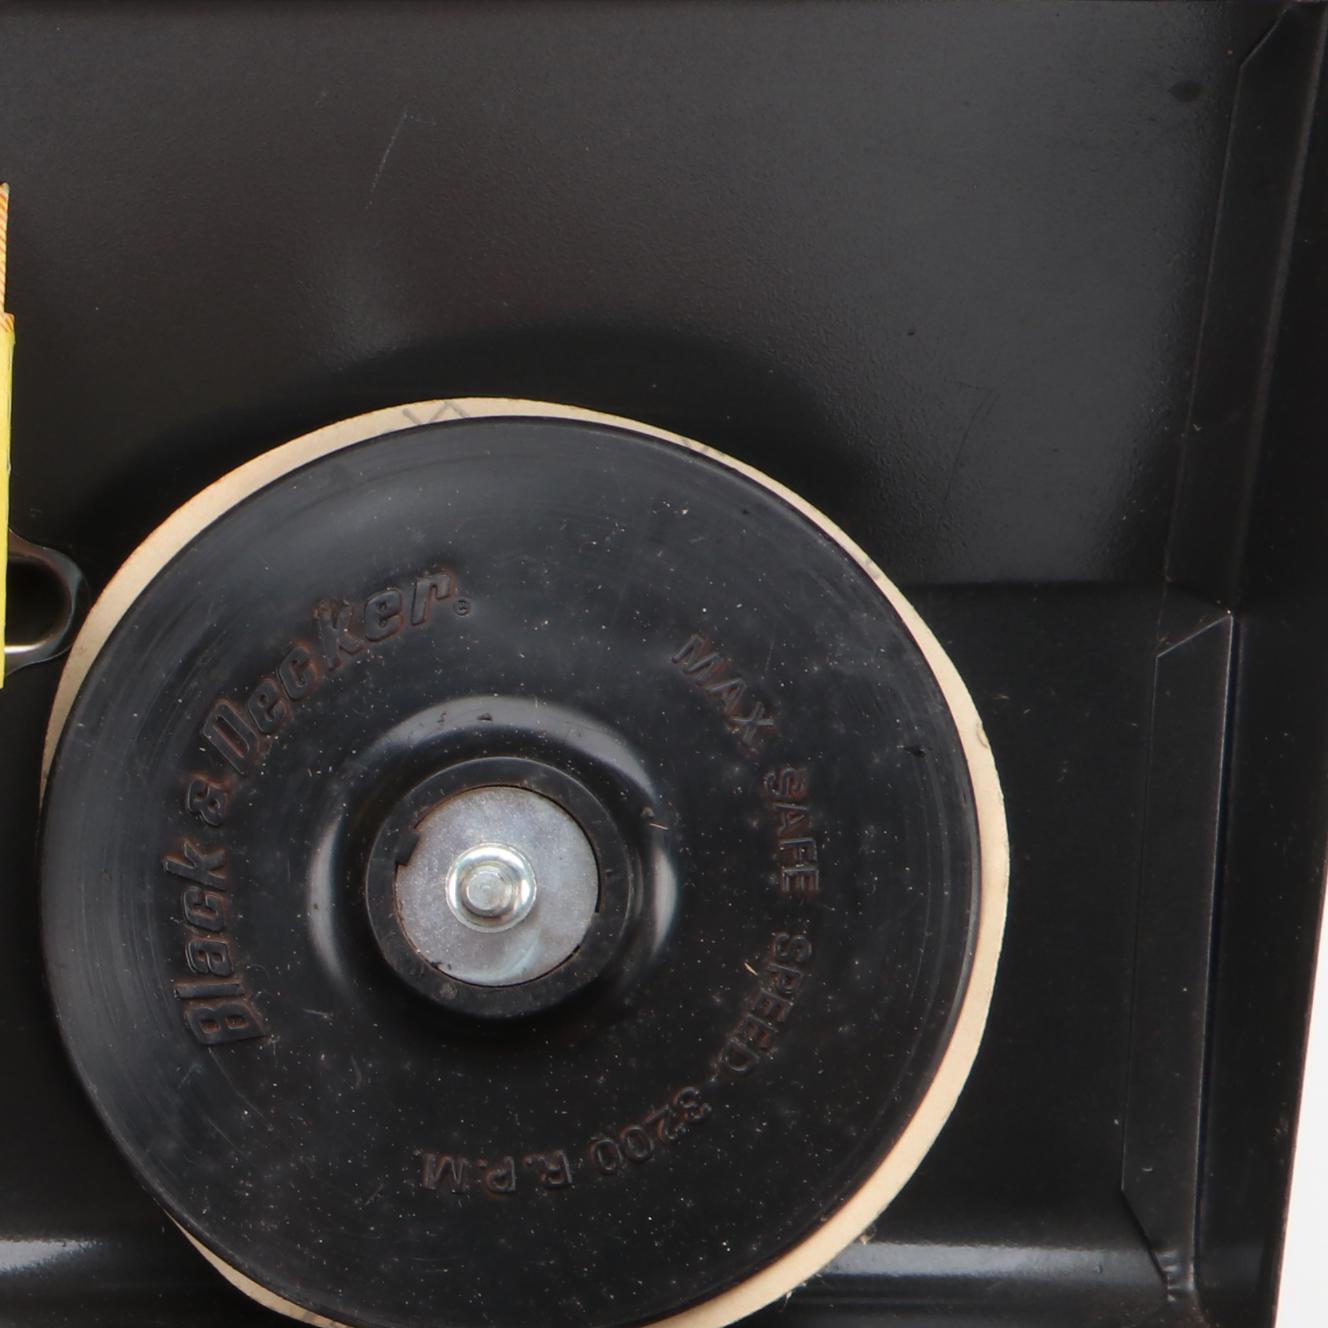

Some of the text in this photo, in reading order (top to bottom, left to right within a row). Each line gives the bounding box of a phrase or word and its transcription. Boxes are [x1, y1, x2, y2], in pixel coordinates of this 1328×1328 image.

[185, 774, 229, 829] &
[765, 767, 822, 897] SAFE
[164, 838, 269, 1046] Black
[589, 1085, 713, 1176] 3200
